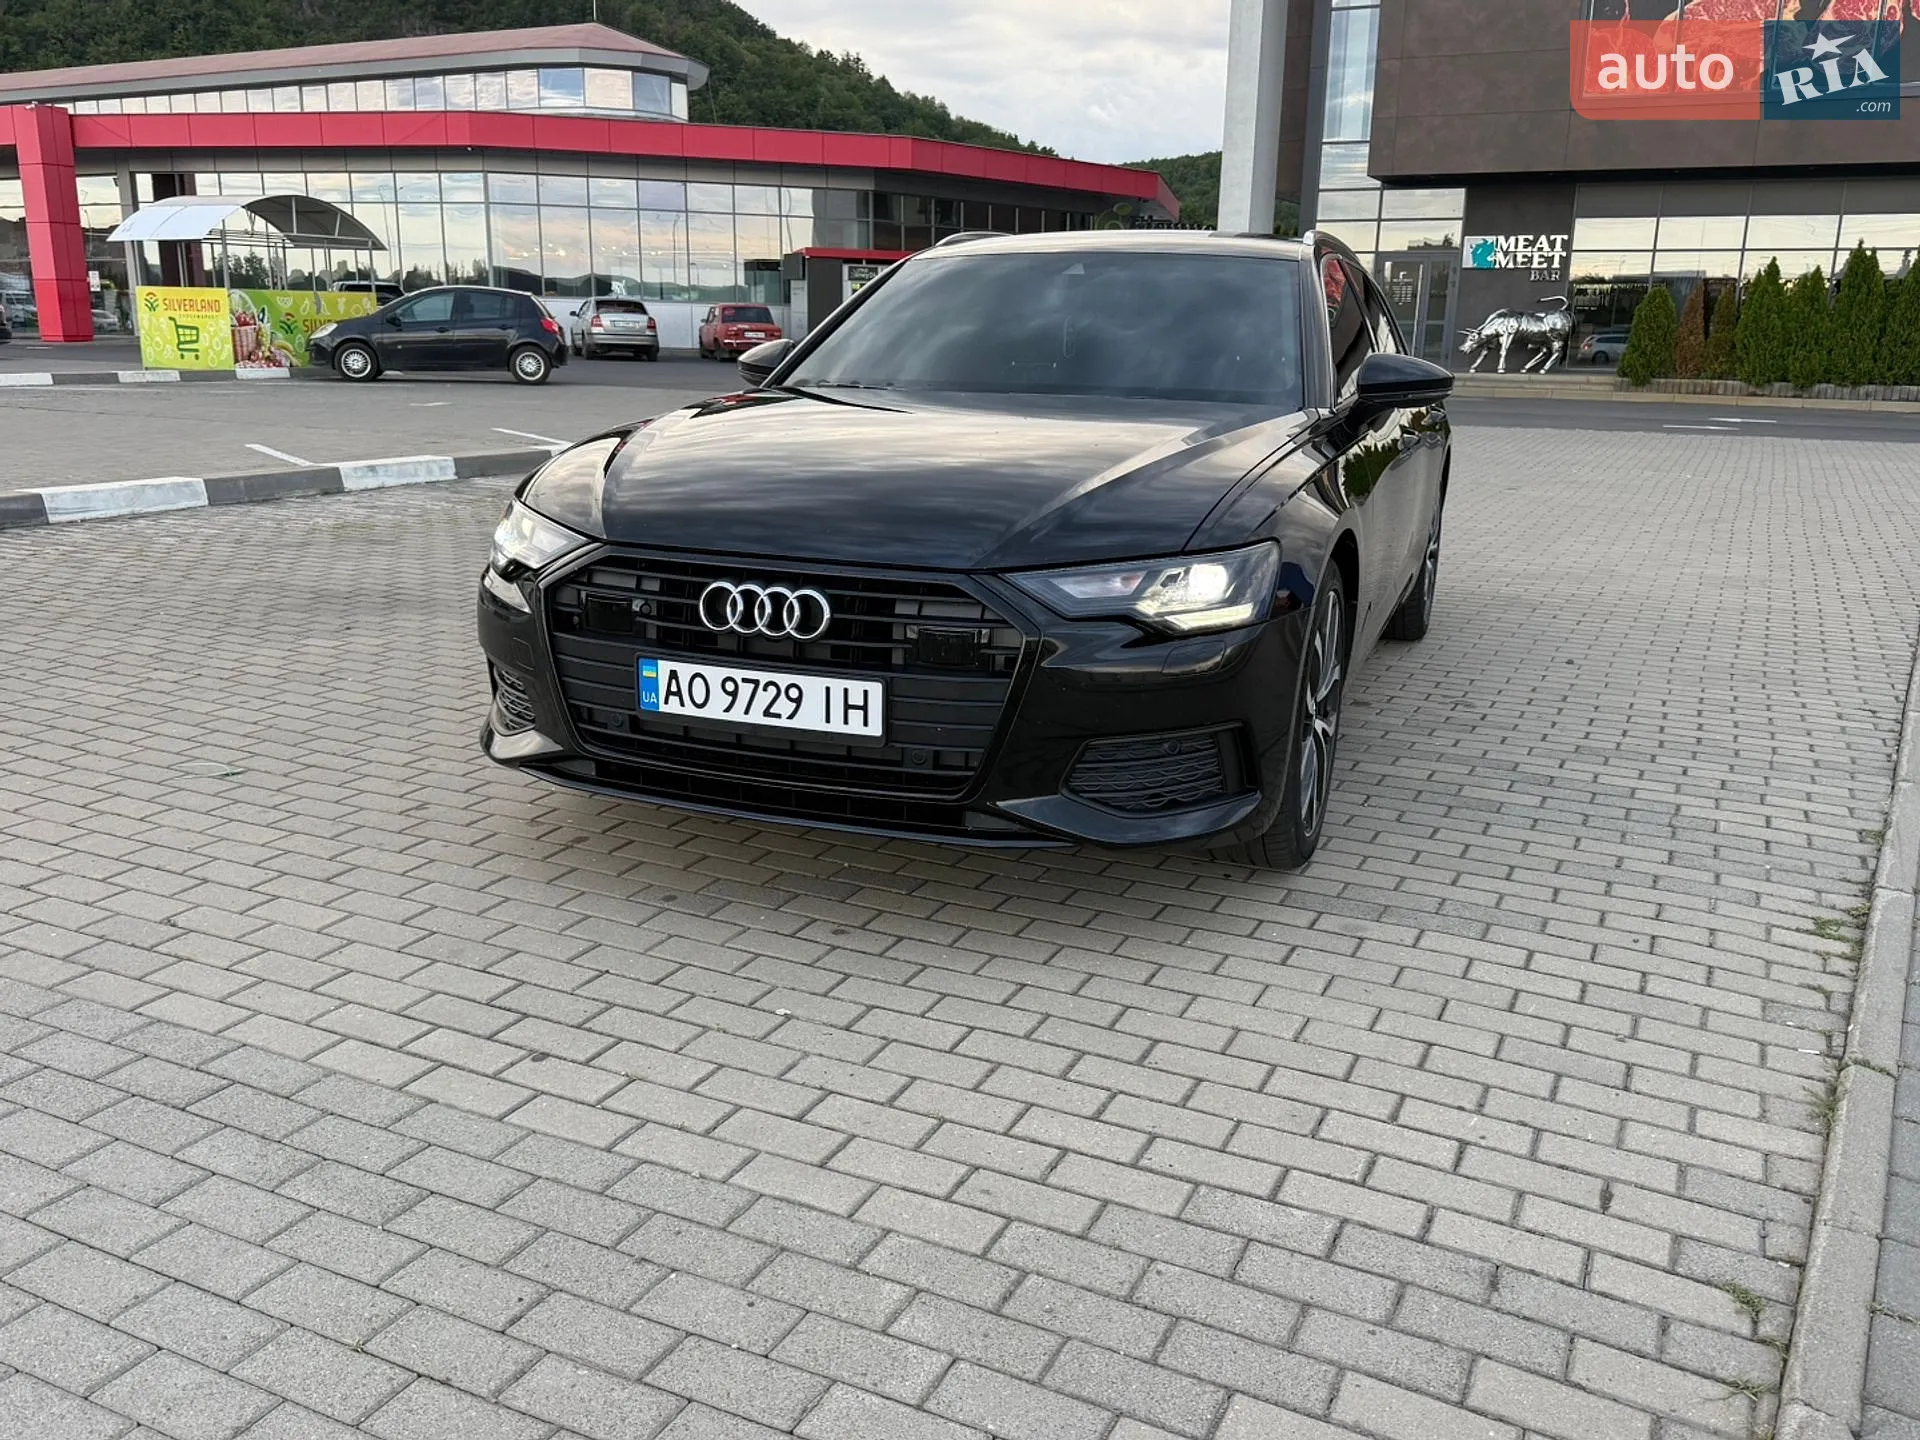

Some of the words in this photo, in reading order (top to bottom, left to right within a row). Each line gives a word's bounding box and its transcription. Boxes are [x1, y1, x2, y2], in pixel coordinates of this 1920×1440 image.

[1497, 235, 1569, 252] MEAT
[1495, 252, 1567, 269] MEET
[1530, 270, 1560, 281] BAR
[163, 298, 221, 313] SILVERLAND
[642, 690, 657, 704] UA
[663, 669, 711, 709] AO
[720, 676, 804, 720] 9729
[825, 686, 869, 727] IH
